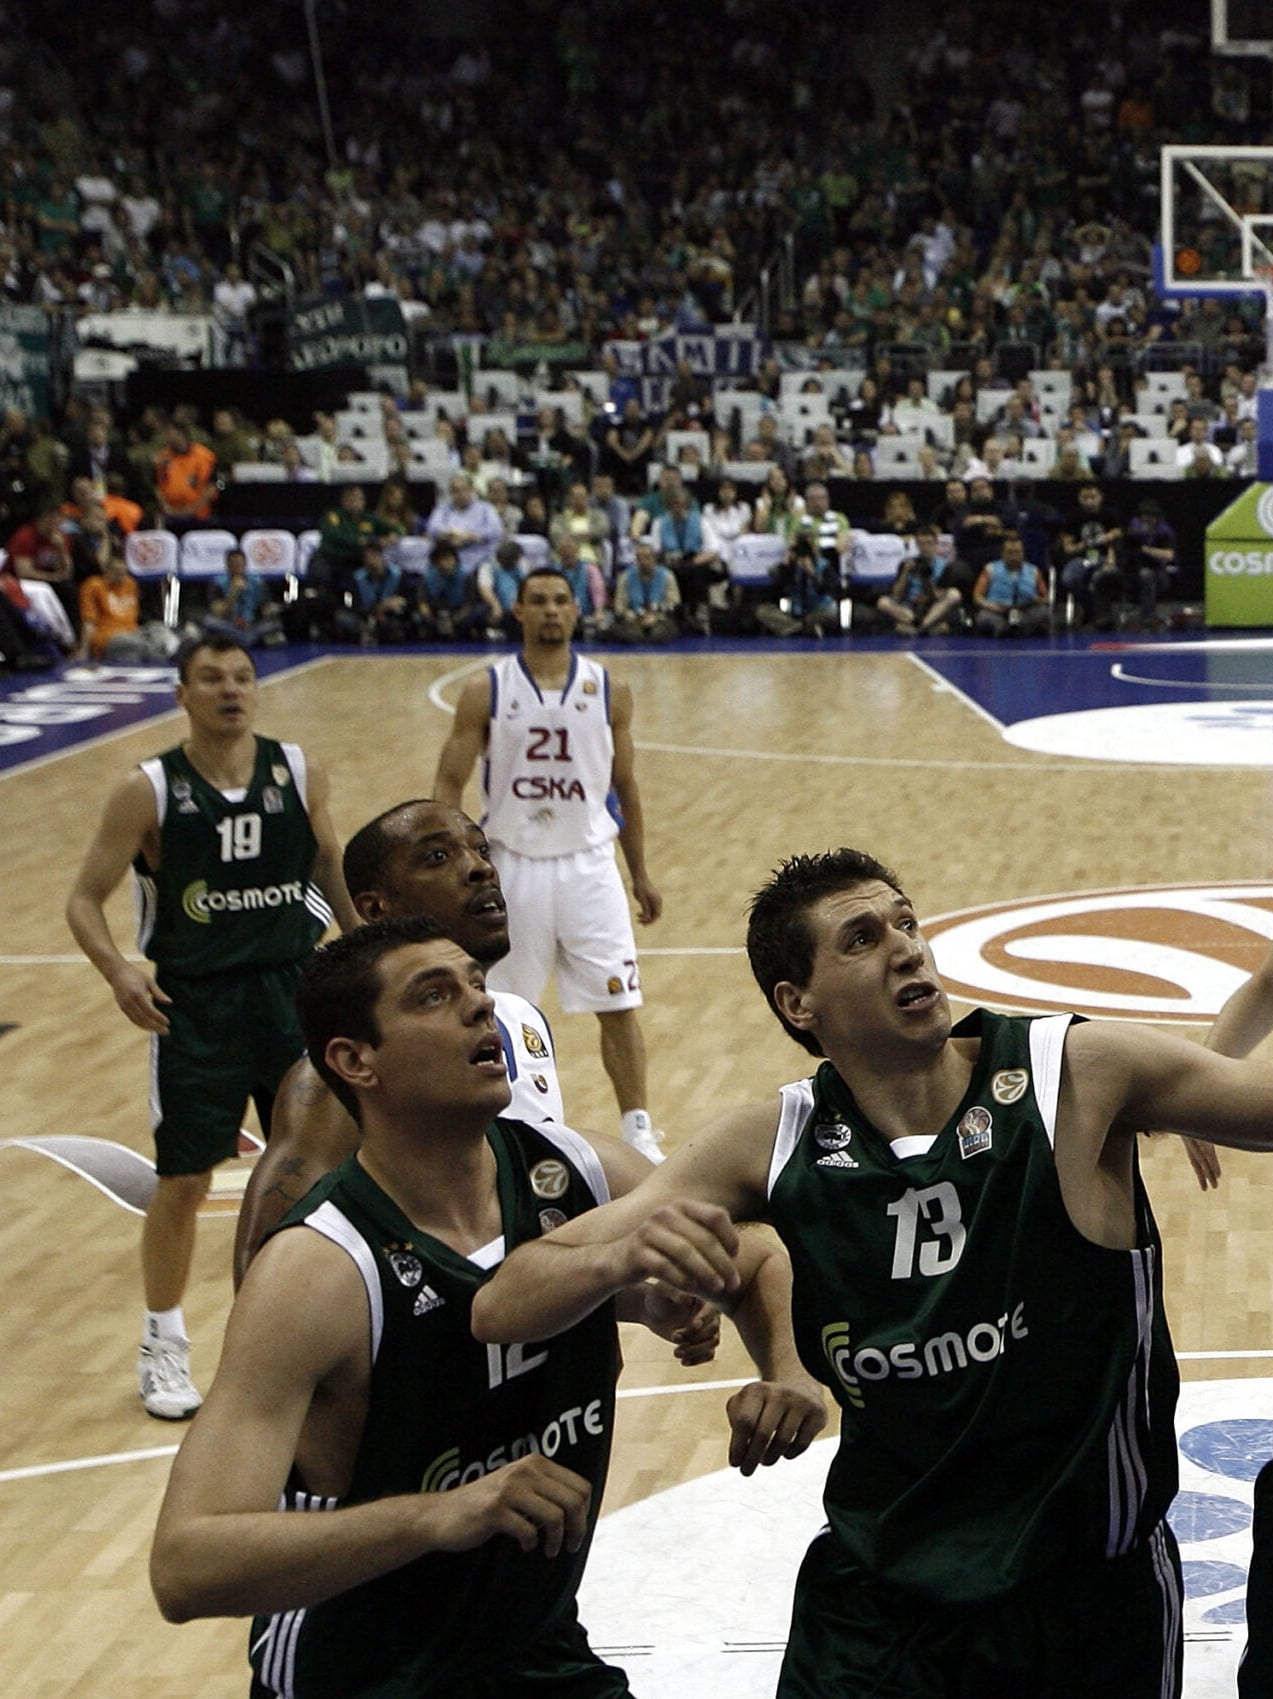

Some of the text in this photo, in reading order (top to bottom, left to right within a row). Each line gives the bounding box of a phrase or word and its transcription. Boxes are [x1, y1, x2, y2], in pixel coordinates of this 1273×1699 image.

[526, 727, 573, 762] 21
[512, 777, 587, 802] CSKA
[215, 812, 262, 863] 19
[886, 1181, 967, 1280] 13
